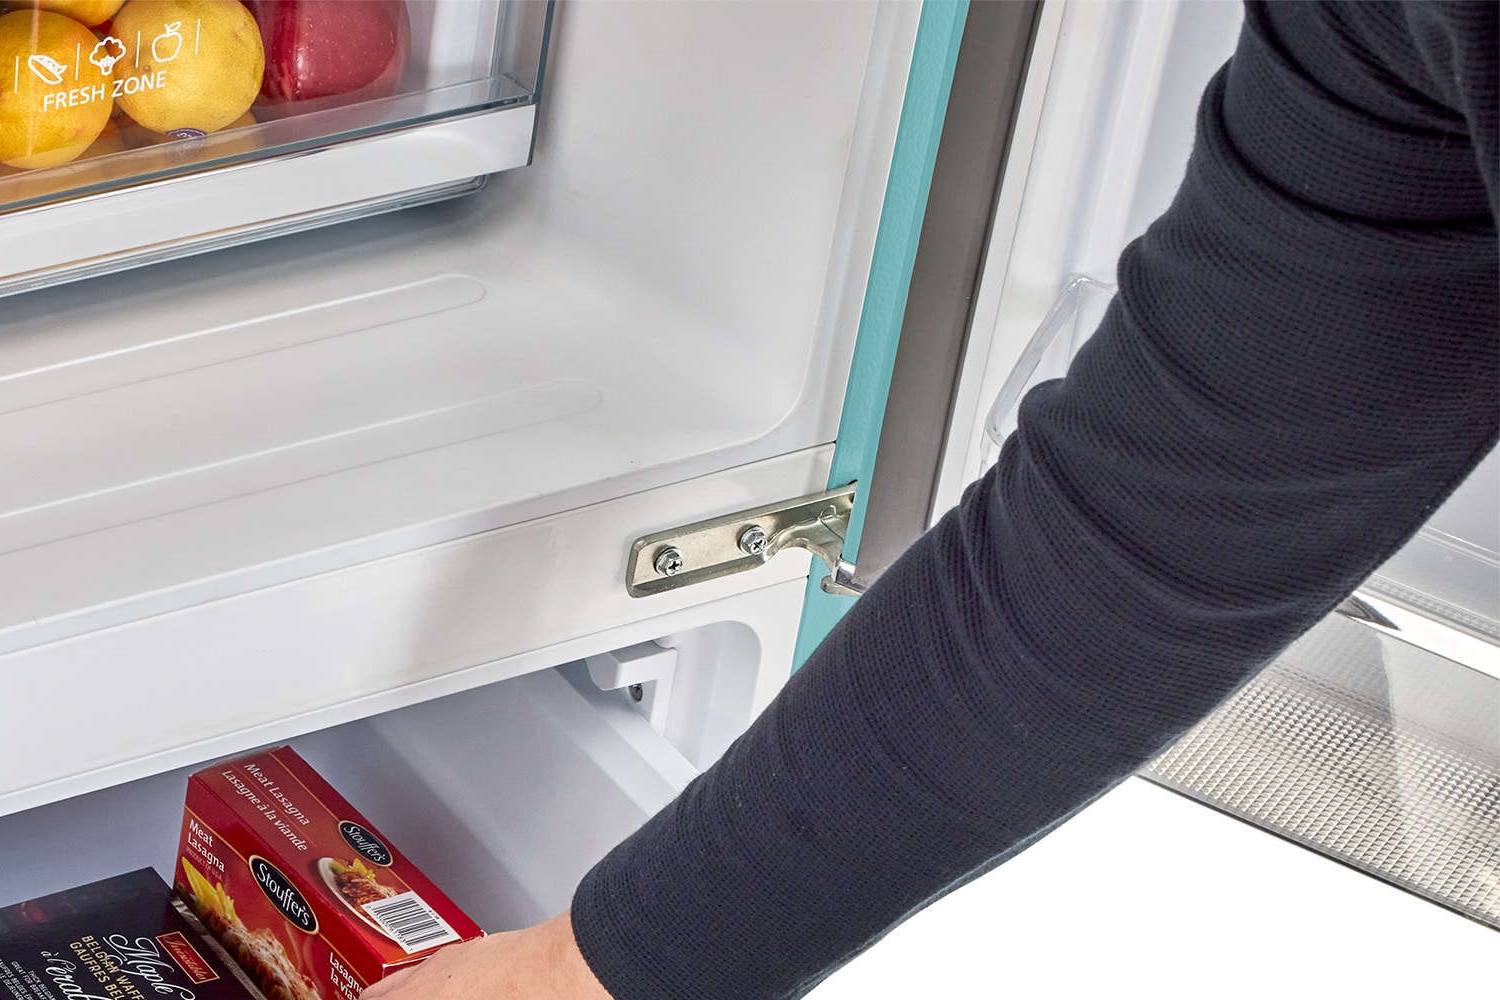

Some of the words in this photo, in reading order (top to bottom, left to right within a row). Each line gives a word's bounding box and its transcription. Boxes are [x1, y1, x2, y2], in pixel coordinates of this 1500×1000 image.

[43, 83, 105, 112] FRESH
[111, 70, 167, 98] ZONE
[222, 770, 260, 804] Lasagne
[264, 809, 277, 820] la
[274, 820, 308, 851] viande
[243, 763, 274, 787] Meat
[268, 787, 310, 825] Lasagna
[188, 832, 225, 872] Lasagna
[189, 819, 213, 847] Meat
[344, 826, 386, 862] Stouffer's
[256, 863, 310, 926] Stouffer's
[11, 960, 26, 975] GREAT
[22, 974, 33, 984] FOR
[69, 941, 110, 984] GAUFRES
[81, 934, 121, 974] BELGIAN
[330, 952, 364, 994] Lasagne
[10, 978, 28, 994] BELGES
[28, 970, 41, 984] THICK
[330, 967, 339, 986] la
